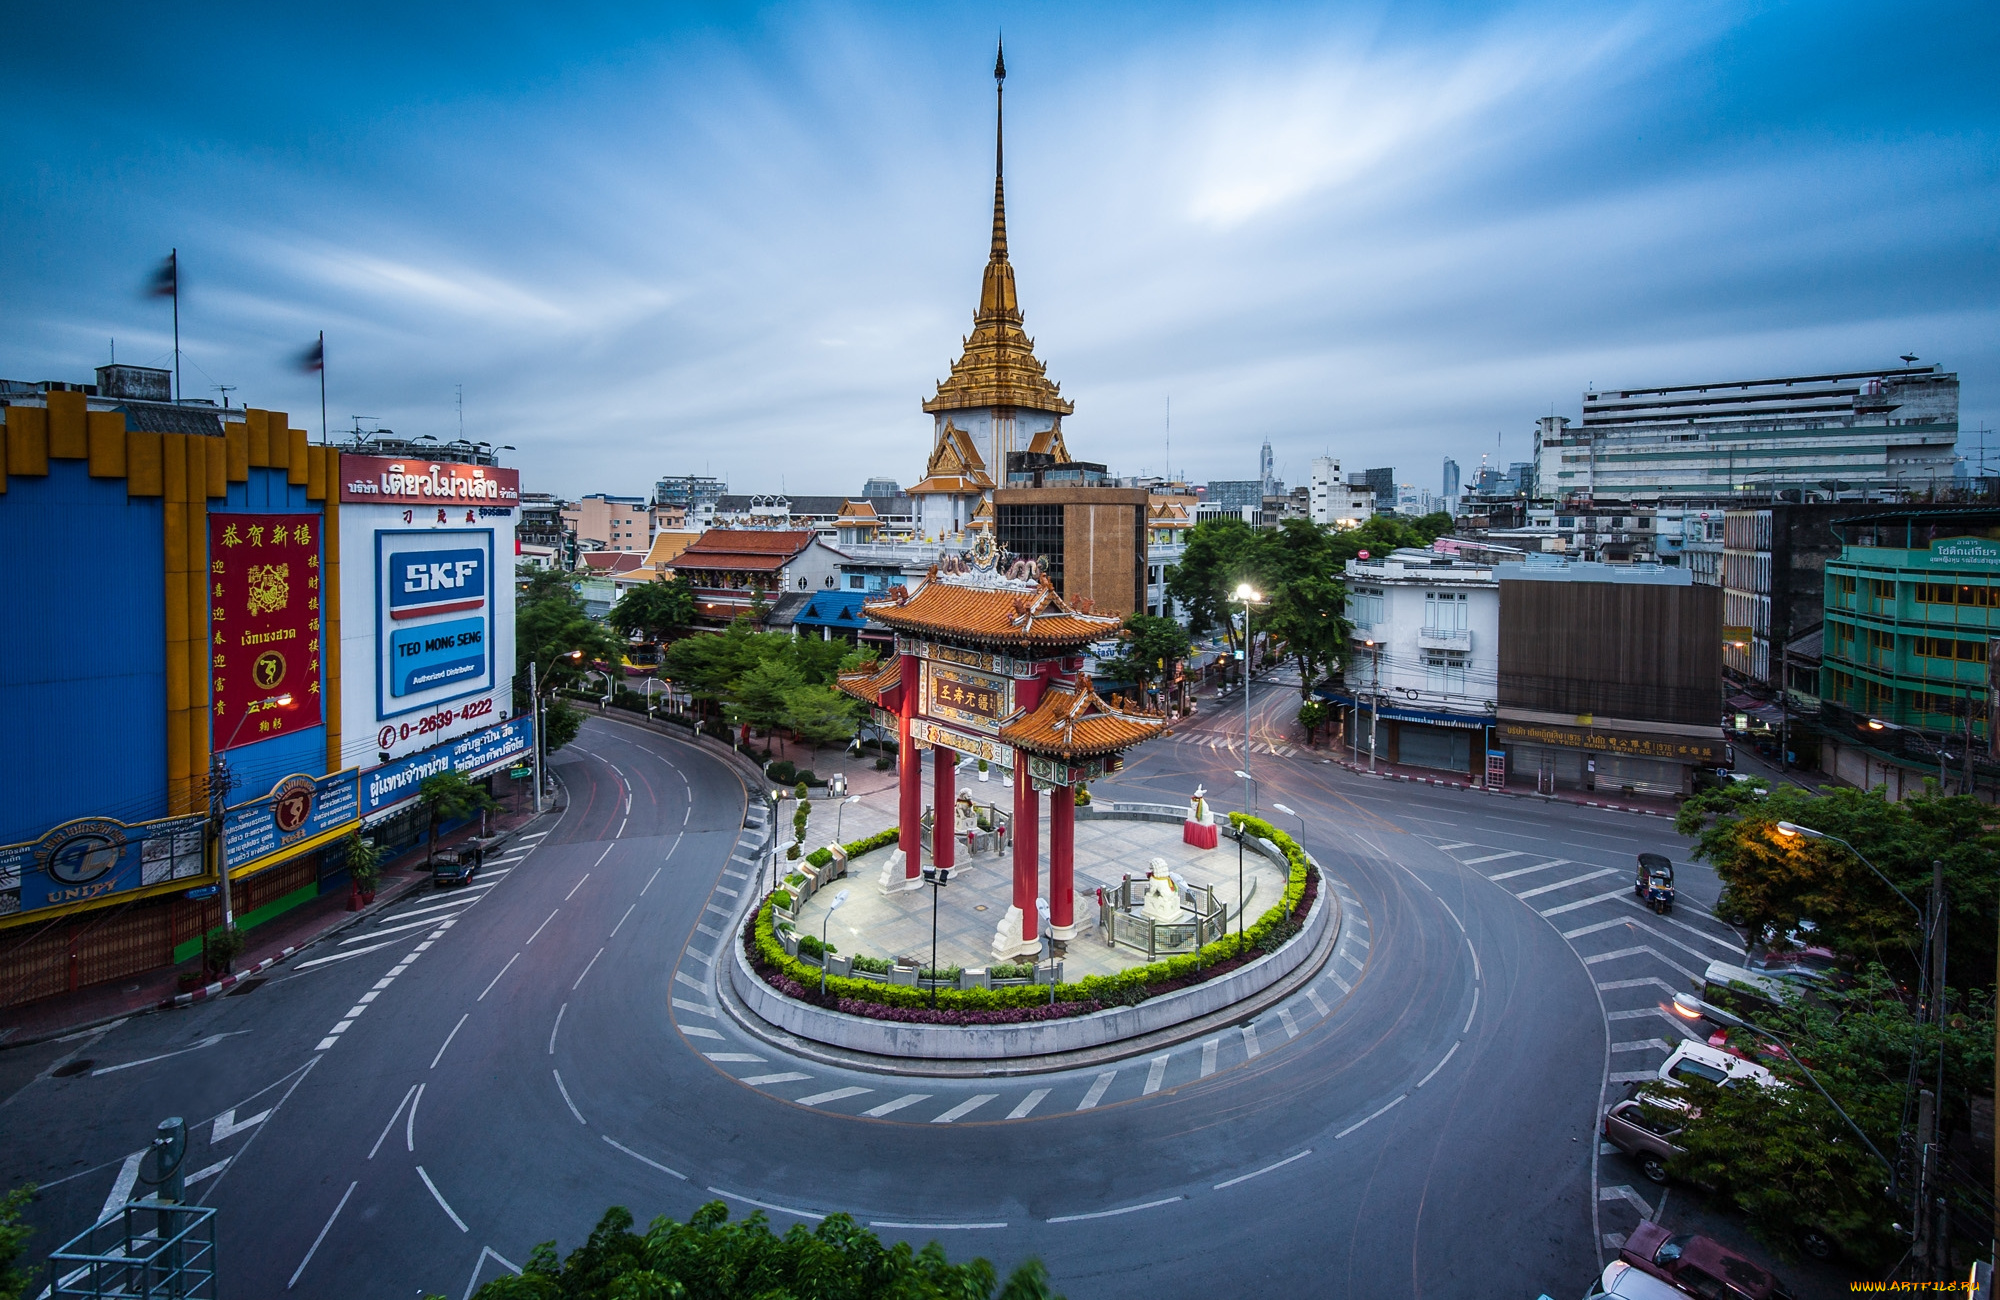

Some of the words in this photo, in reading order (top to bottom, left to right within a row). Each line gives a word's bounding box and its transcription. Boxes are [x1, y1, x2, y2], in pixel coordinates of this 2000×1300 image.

[348, 479, 379, 495] บริษัท
[499, 486, 518, 499] จำกัด
[221, 523, 312, 548] 恭贺新禧
[404, 560, 478, 593] SKF
[398, 641, 421, 658] TEO
[425, 635, 455, 653] MONG
[457, 630, 482, 647] SENG
[413, 670, 445, 685] Authorized
[446, 664, 475, 677] Distributor
[400, 698, 493, 741] 0-2639-4222
[1507, 725, 1526, 737] บริษัท
[369, 754, 449, 807] ผู้แทนจำหน่าย
[281, 828, 306, 845] Kett
[48, 879, 117, 903] UNITY
